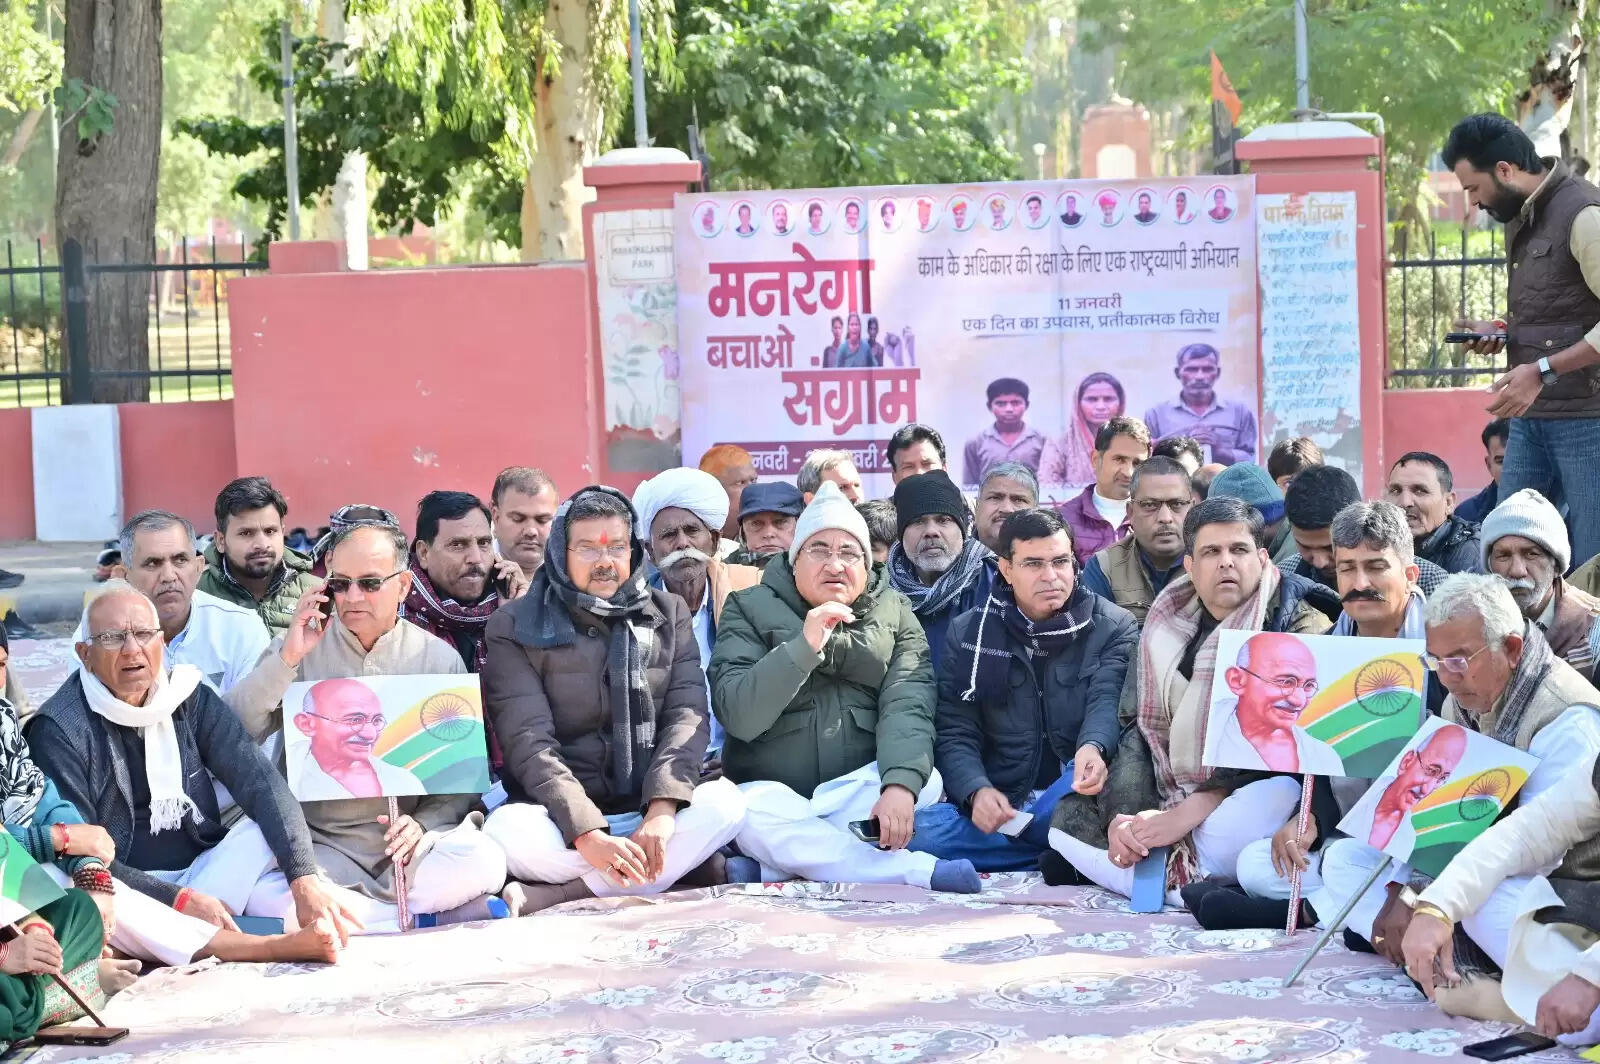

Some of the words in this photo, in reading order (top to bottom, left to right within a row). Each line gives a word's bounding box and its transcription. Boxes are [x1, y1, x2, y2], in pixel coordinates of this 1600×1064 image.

[918, 256, 944, 277] काम
[947, 248, 960, 275] के
[964, 248, 1012, 276] अधिकार
[1016, 246, 1032, 275] की
[1035, 252, 1058, 275] रक्षा
[1061, 245, 1075, 272] के
[1077, 245, 1101, 273] लिए
[1105, 251, 1127, 272] एक
[1130, 241, 1188, 276] राष्ट्रव्यापी
[1191, 241, 1240, 269] अभियान
[708, 242, 875, 318] मनरेगा
[962, 318, 987, 331] एक
[991, 314, 1015, 331] दिन
[1020, 317, 1039, 329] का
[1043, 315, 1095, 330] उपवास,
[1098, 311, 1176, 328] प्रतीकात्मक
[1180, 308, 1220, 325] विरोध
[1058, 298, 1070, 310] 11
[1075, 293, 1122, 310] जनवरी
[706, 324, 795, 369] बचाओ
[782, 356, 920, 436] संग्राम
[748, 445, 788, 471] नवरी
